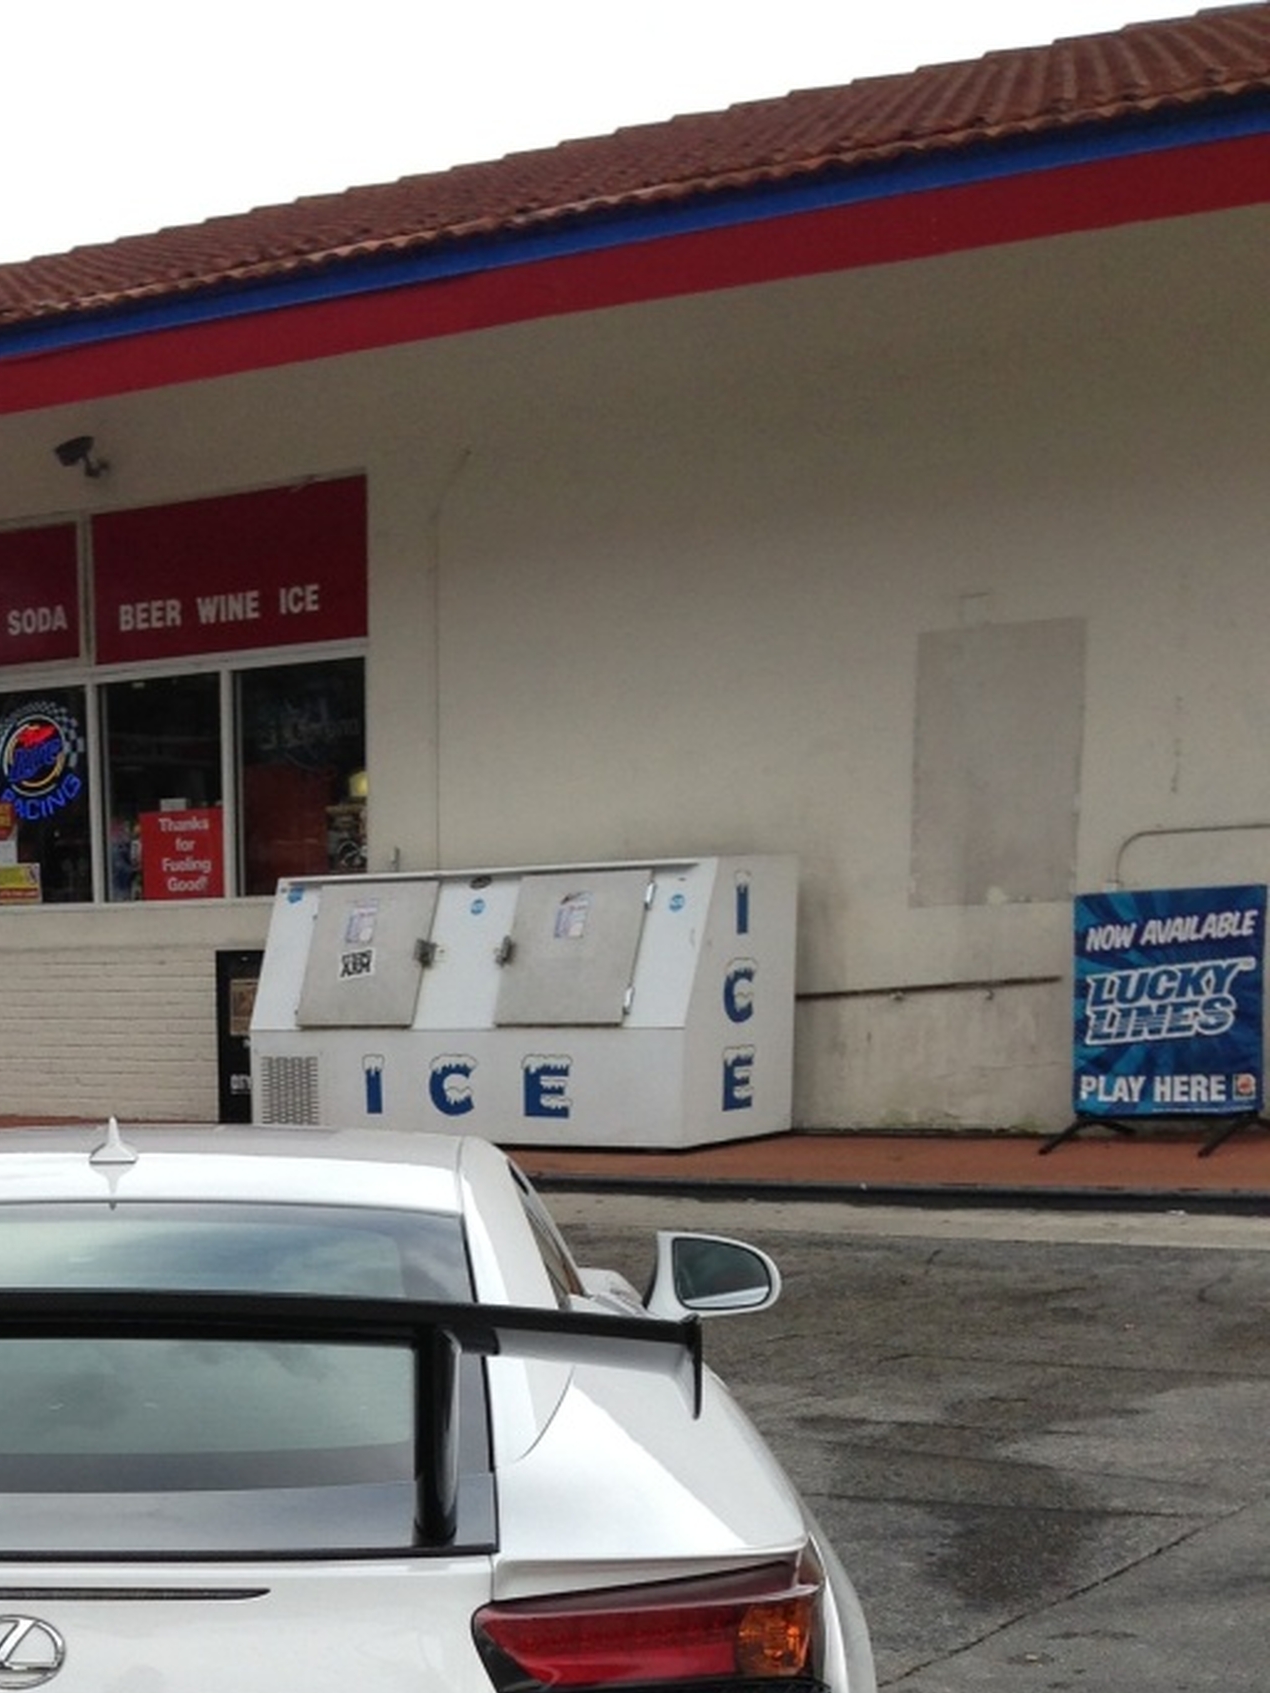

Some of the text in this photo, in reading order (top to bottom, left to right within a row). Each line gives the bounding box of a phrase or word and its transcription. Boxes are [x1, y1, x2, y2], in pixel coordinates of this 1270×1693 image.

[7, 605, 68, 635] SODA
[119, 584, 320, 632] BEER WINE ICE
[0, 772, 83, 820] RACING
[158, 816, 210, 833] Thanks
[174, 836, 196, 852] for
[162, 856, 213, 874] Fueling
[1085, 909, 1259, 952] NOW AVAILABLE
[721, 869, 758, 1112] ICE
[1086, 956, 1257, 1007] LUCKY
[1085, 996, 1237, 1046] LINES
[360, 1052, 574, 1120] ICE
[1081, 1074, 1226, 1102] PLAY HERE
